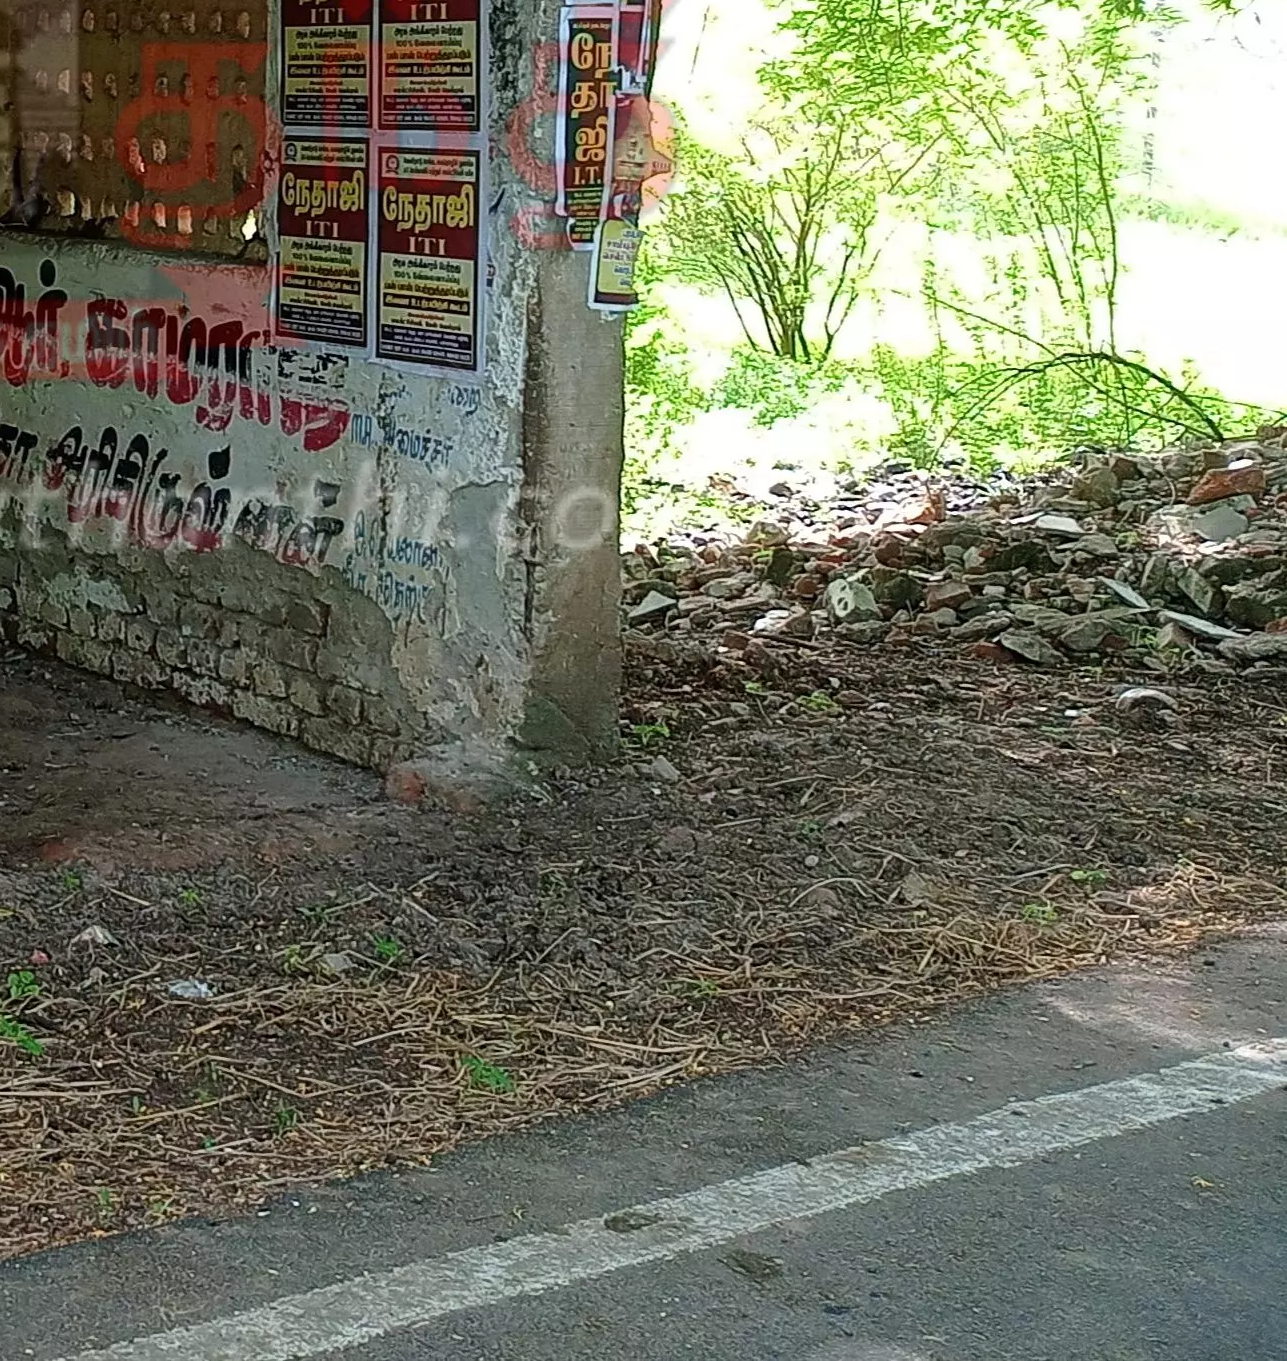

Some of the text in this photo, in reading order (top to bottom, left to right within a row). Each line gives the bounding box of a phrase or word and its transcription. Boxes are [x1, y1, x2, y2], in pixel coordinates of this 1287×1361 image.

[310, 7, 345, 24] ITI
[409, 2, 448, 20] ITI
[573, 165, 602, 185] I.T.
[281, 170, 365, 217] நேதாஜி
[382, 184, 475, 233] நேதாஜி
[305, 220, 340, 238] ITI
[407, 236, 446, 256] ITI
